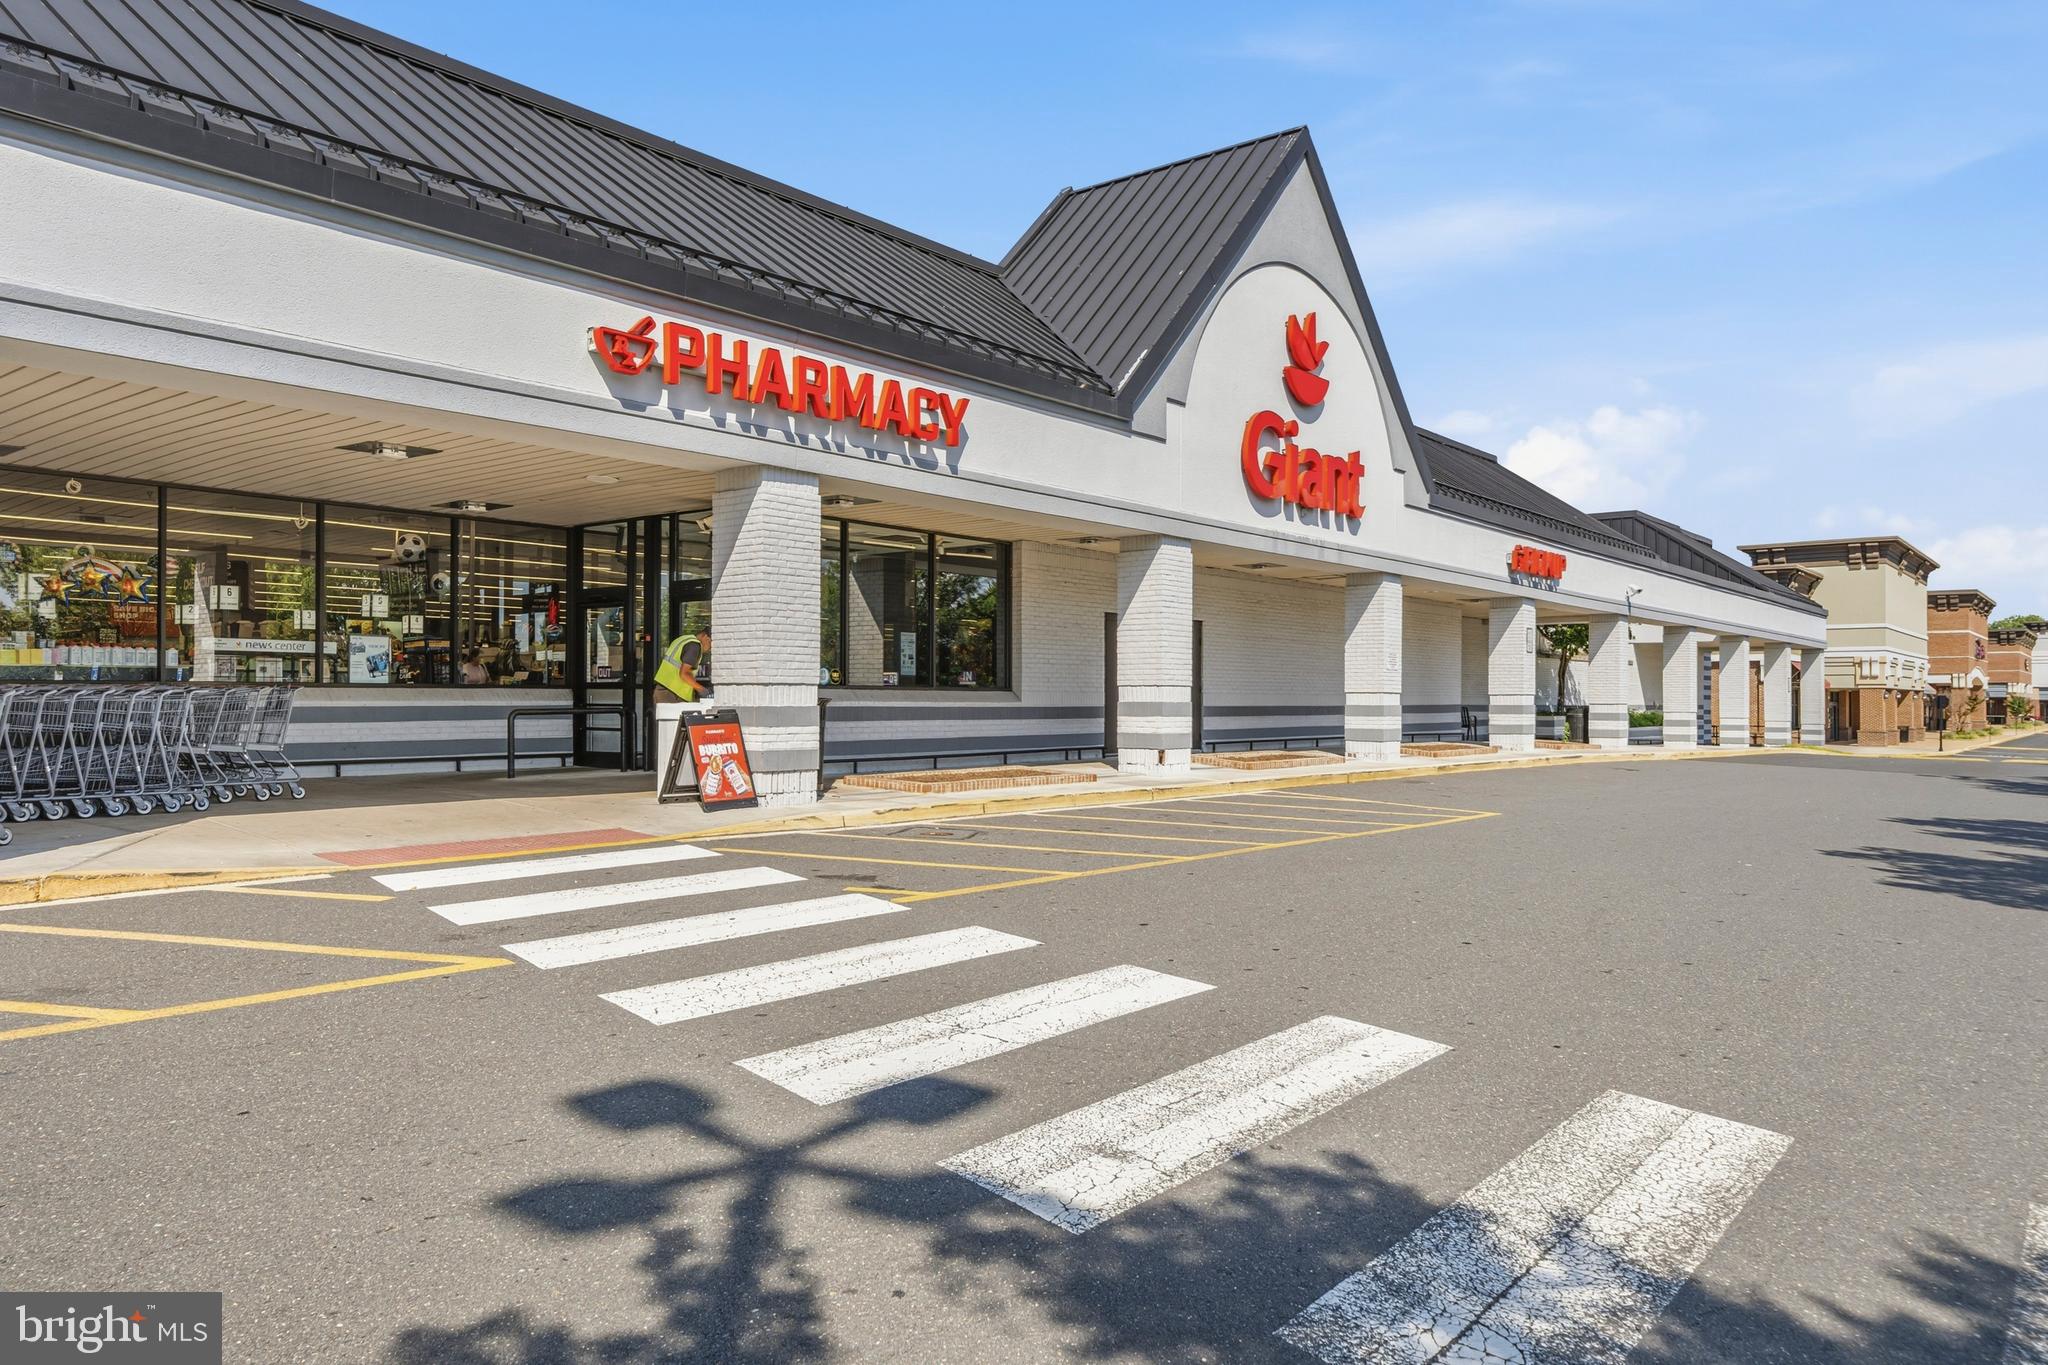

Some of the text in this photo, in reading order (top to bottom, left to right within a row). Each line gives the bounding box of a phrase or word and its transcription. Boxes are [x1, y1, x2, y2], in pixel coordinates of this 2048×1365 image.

[662, 321, 970, 447] PHARMACY
[1241, 410, 1365, 519] Giant
[226, 587, 233, 597] 6
[188, 605, 194, 614] 2
[307, 611, 312, 619] 3
[245, 641, 306, 651] news center
[598, 667, 611, 678] OUT
[698, 743, 739, 757] BURRITO
